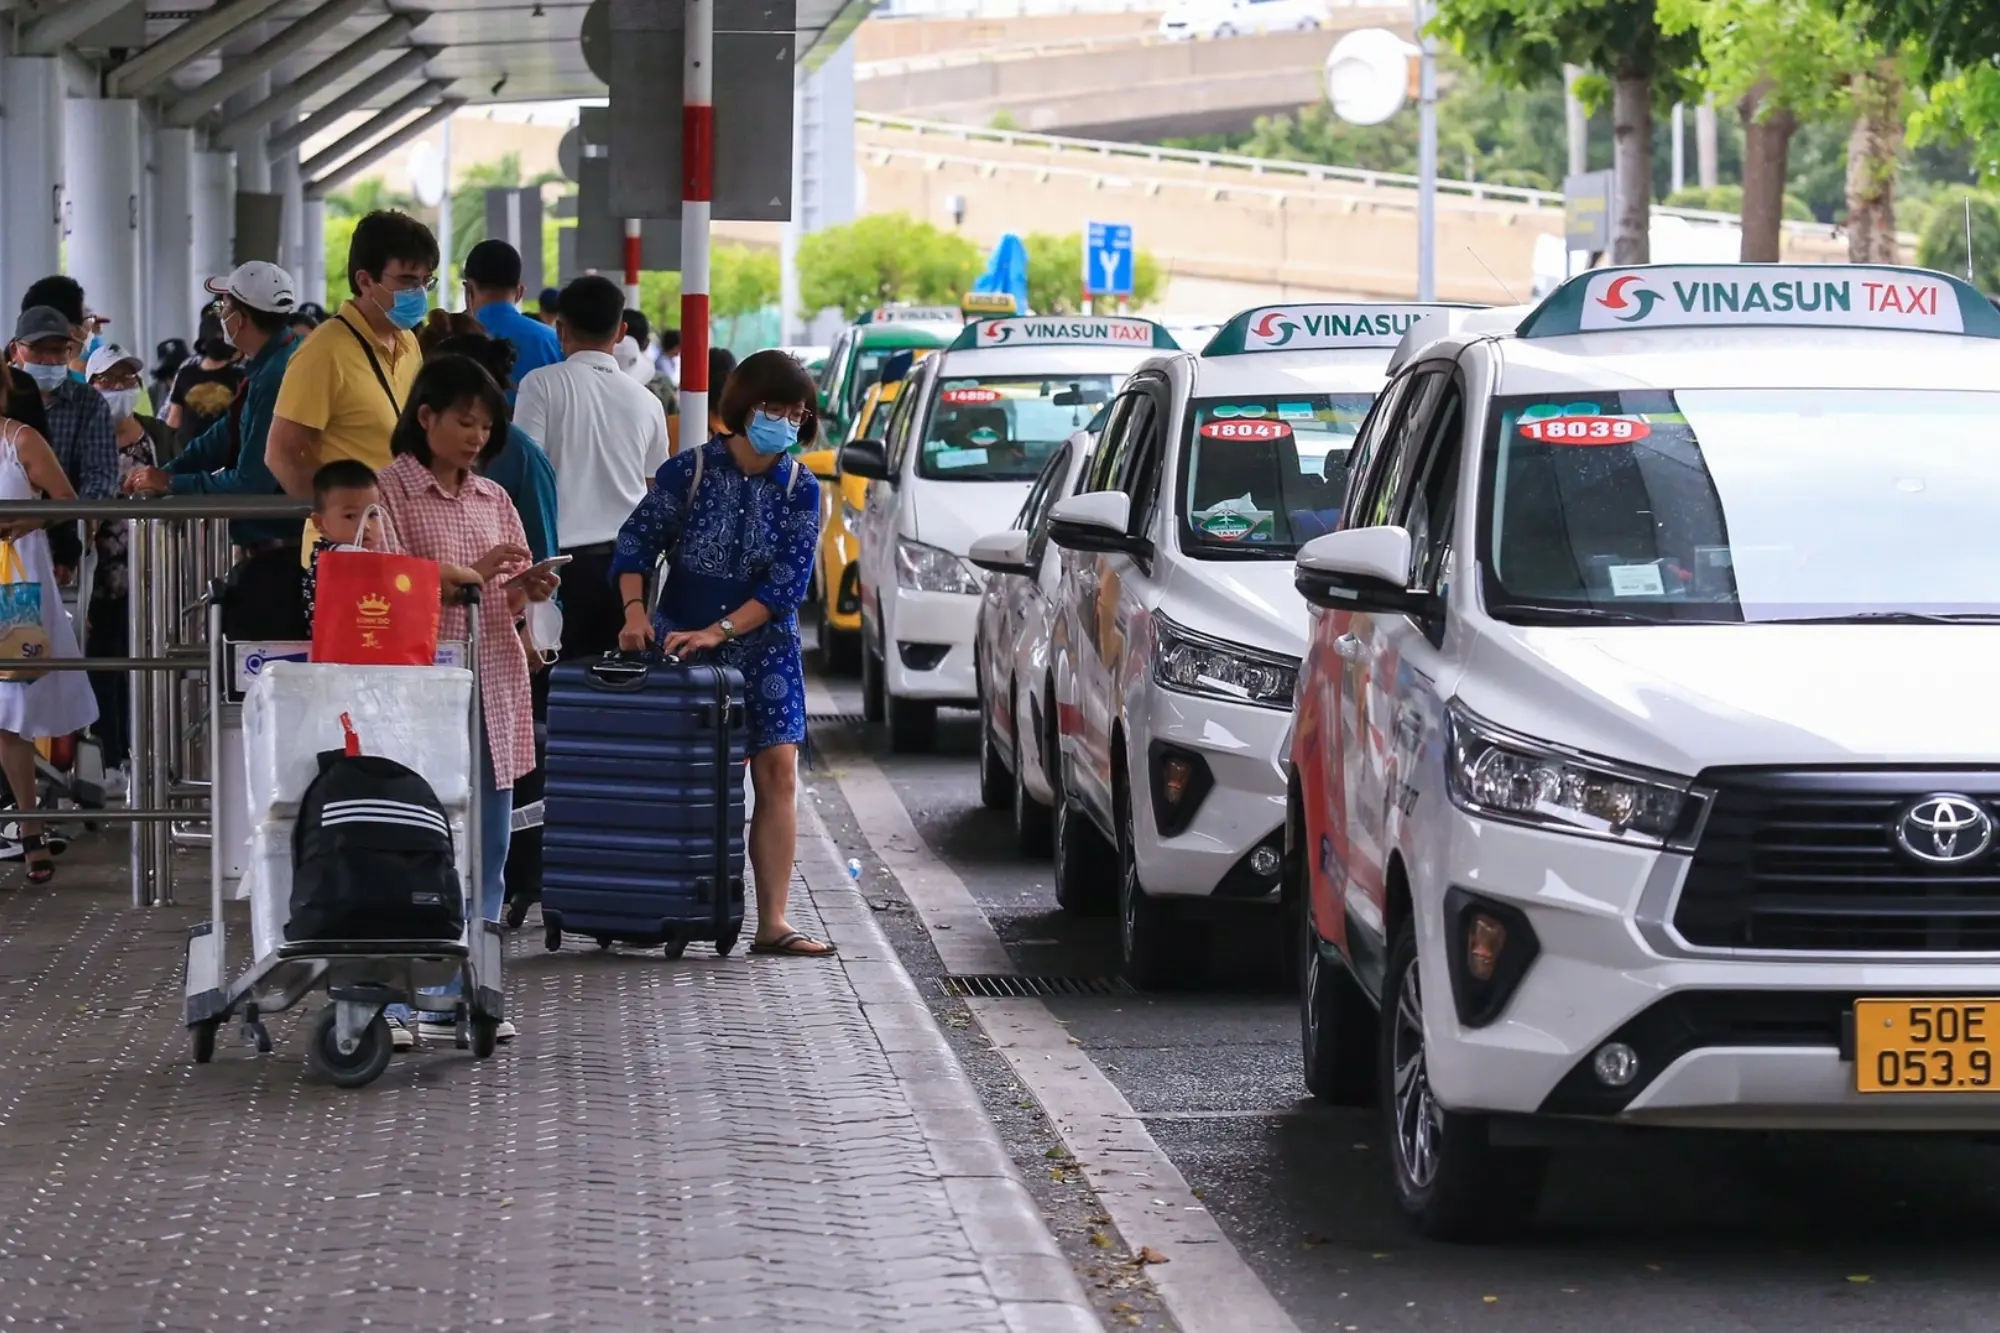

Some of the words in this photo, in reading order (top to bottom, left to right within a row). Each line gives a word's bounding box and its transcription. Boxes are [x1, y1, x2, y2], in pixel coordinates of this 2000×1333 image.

[1673, 281, 1850, 312] VINASUN
[1862, 283, 1937, 315] TAXI
[1024, 323, 1108, 338] VINASUN
[1110, 325, 1148, 341] TAXI
[1209, 424, 1282, 437] 18041
[1528, 421, 1632, 438] 18039
[1909, 1006, 1986, 1043] 50E
[1877, 1049, 1992, 1086] 053.9
